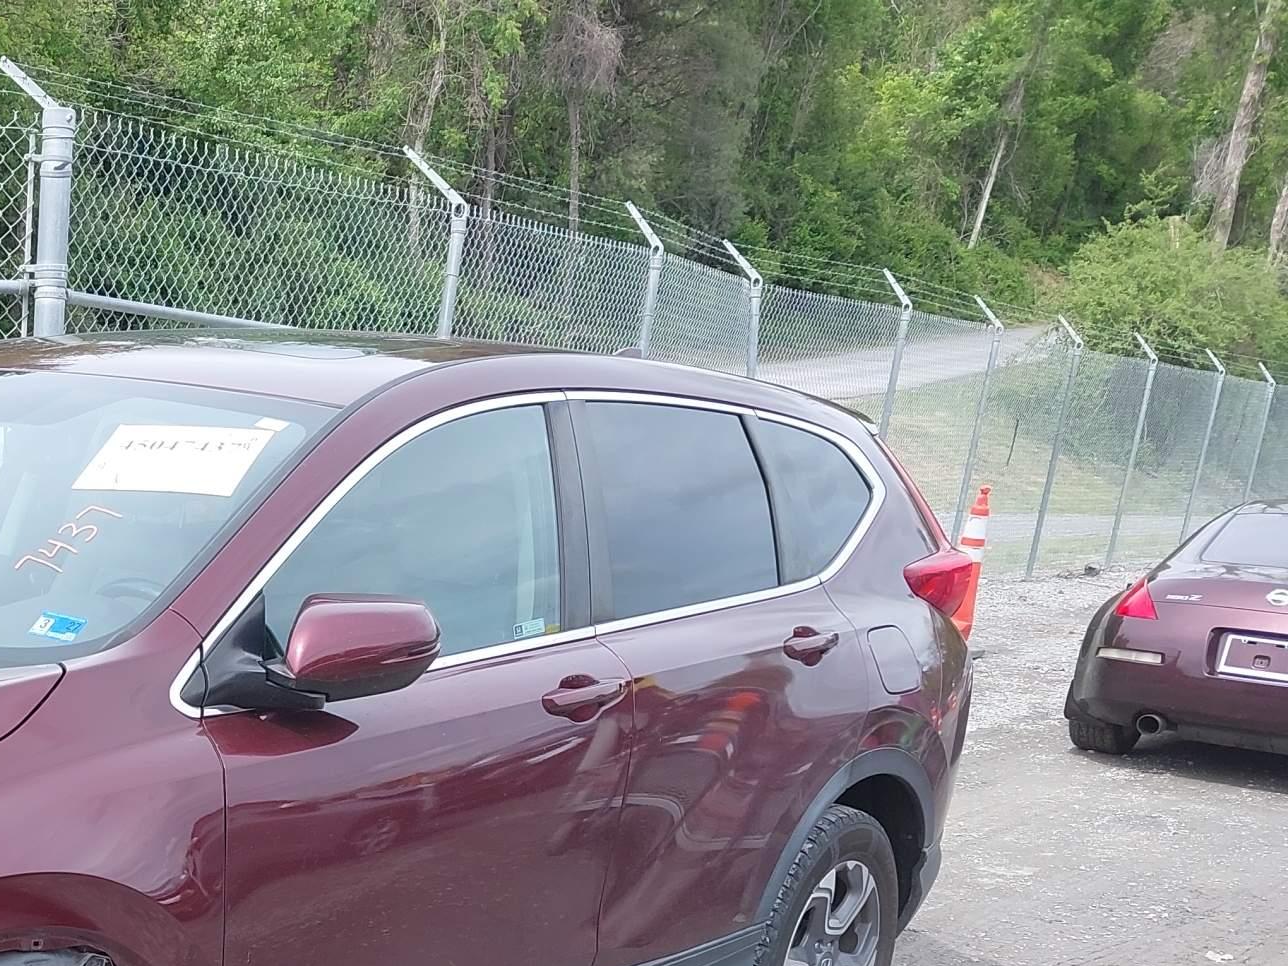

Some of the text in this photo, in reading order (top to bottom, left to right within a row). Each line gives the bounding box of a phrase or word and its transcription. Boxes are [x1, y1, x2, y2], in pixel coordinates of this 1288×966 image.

[14, 505, 123, 574] 7437
[39, 618, 82, 632] 3 27
